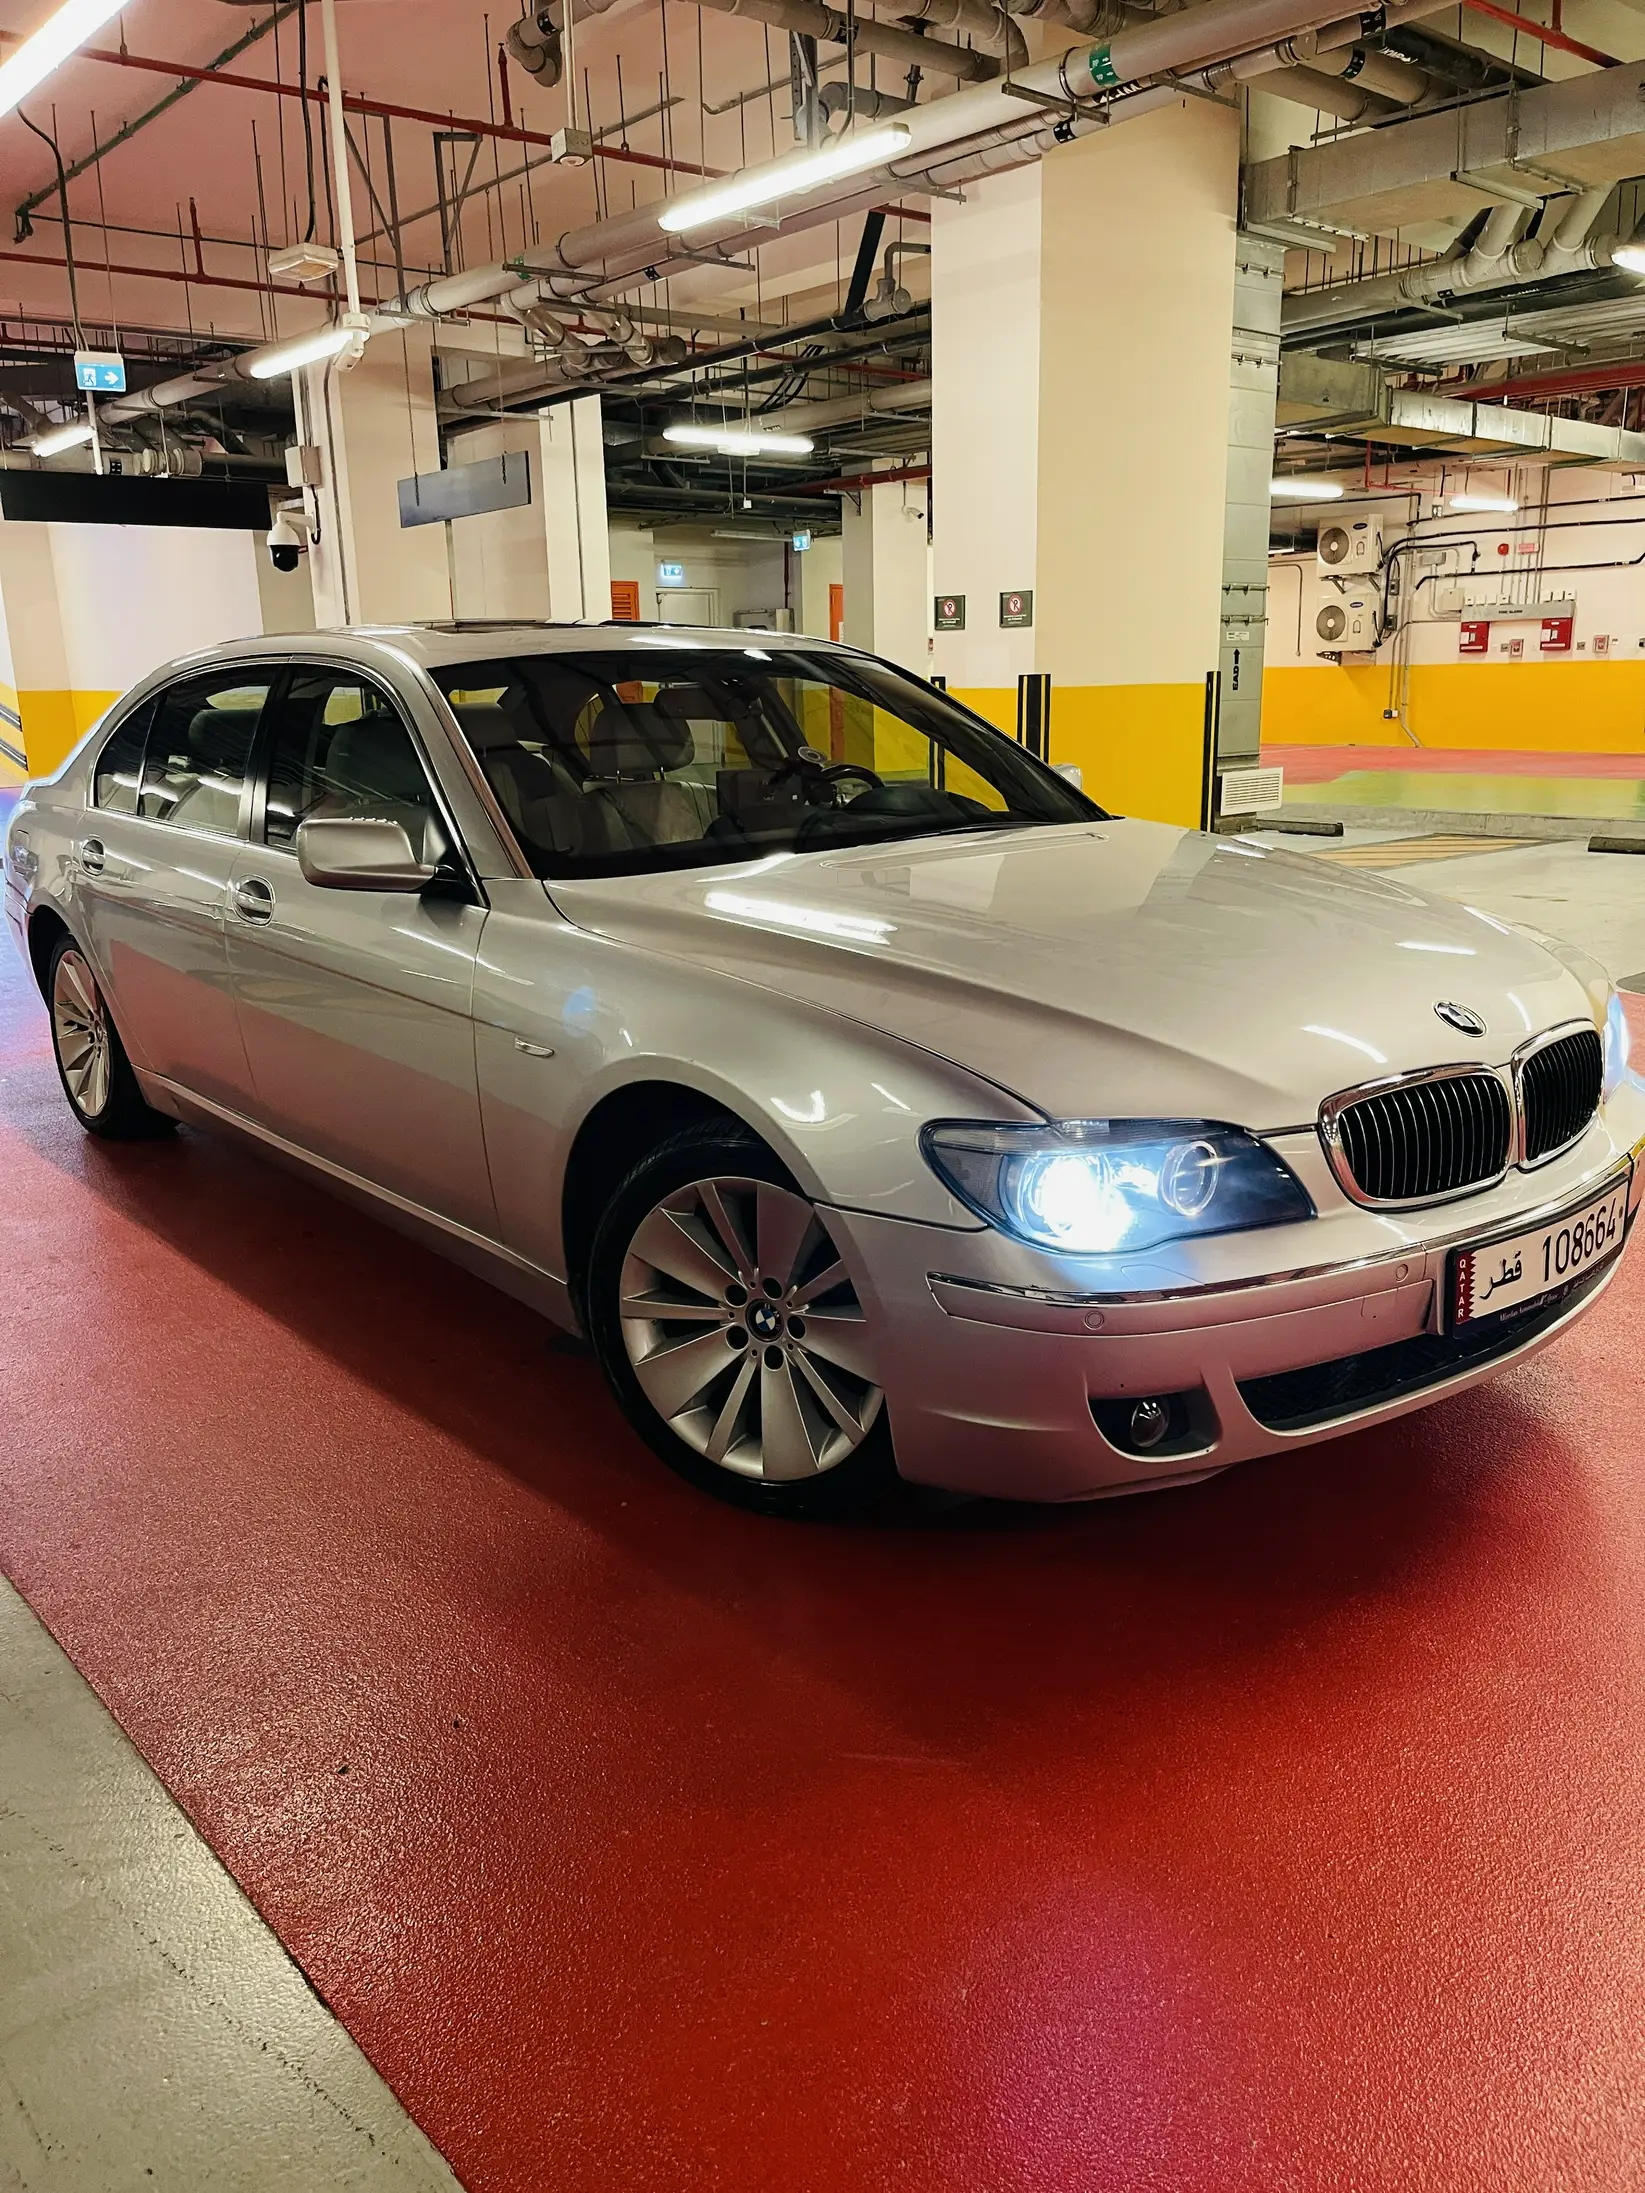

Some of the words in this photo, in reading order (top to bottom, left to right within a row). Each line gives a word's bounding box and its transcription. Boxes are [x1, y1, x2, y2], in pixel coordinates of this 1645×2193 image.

[1542, 1197, 1617, 1282] 108664
[1457, 1259, 1467, 1318] QATAR
[1479, 1250, 1522, 1300] قطر
